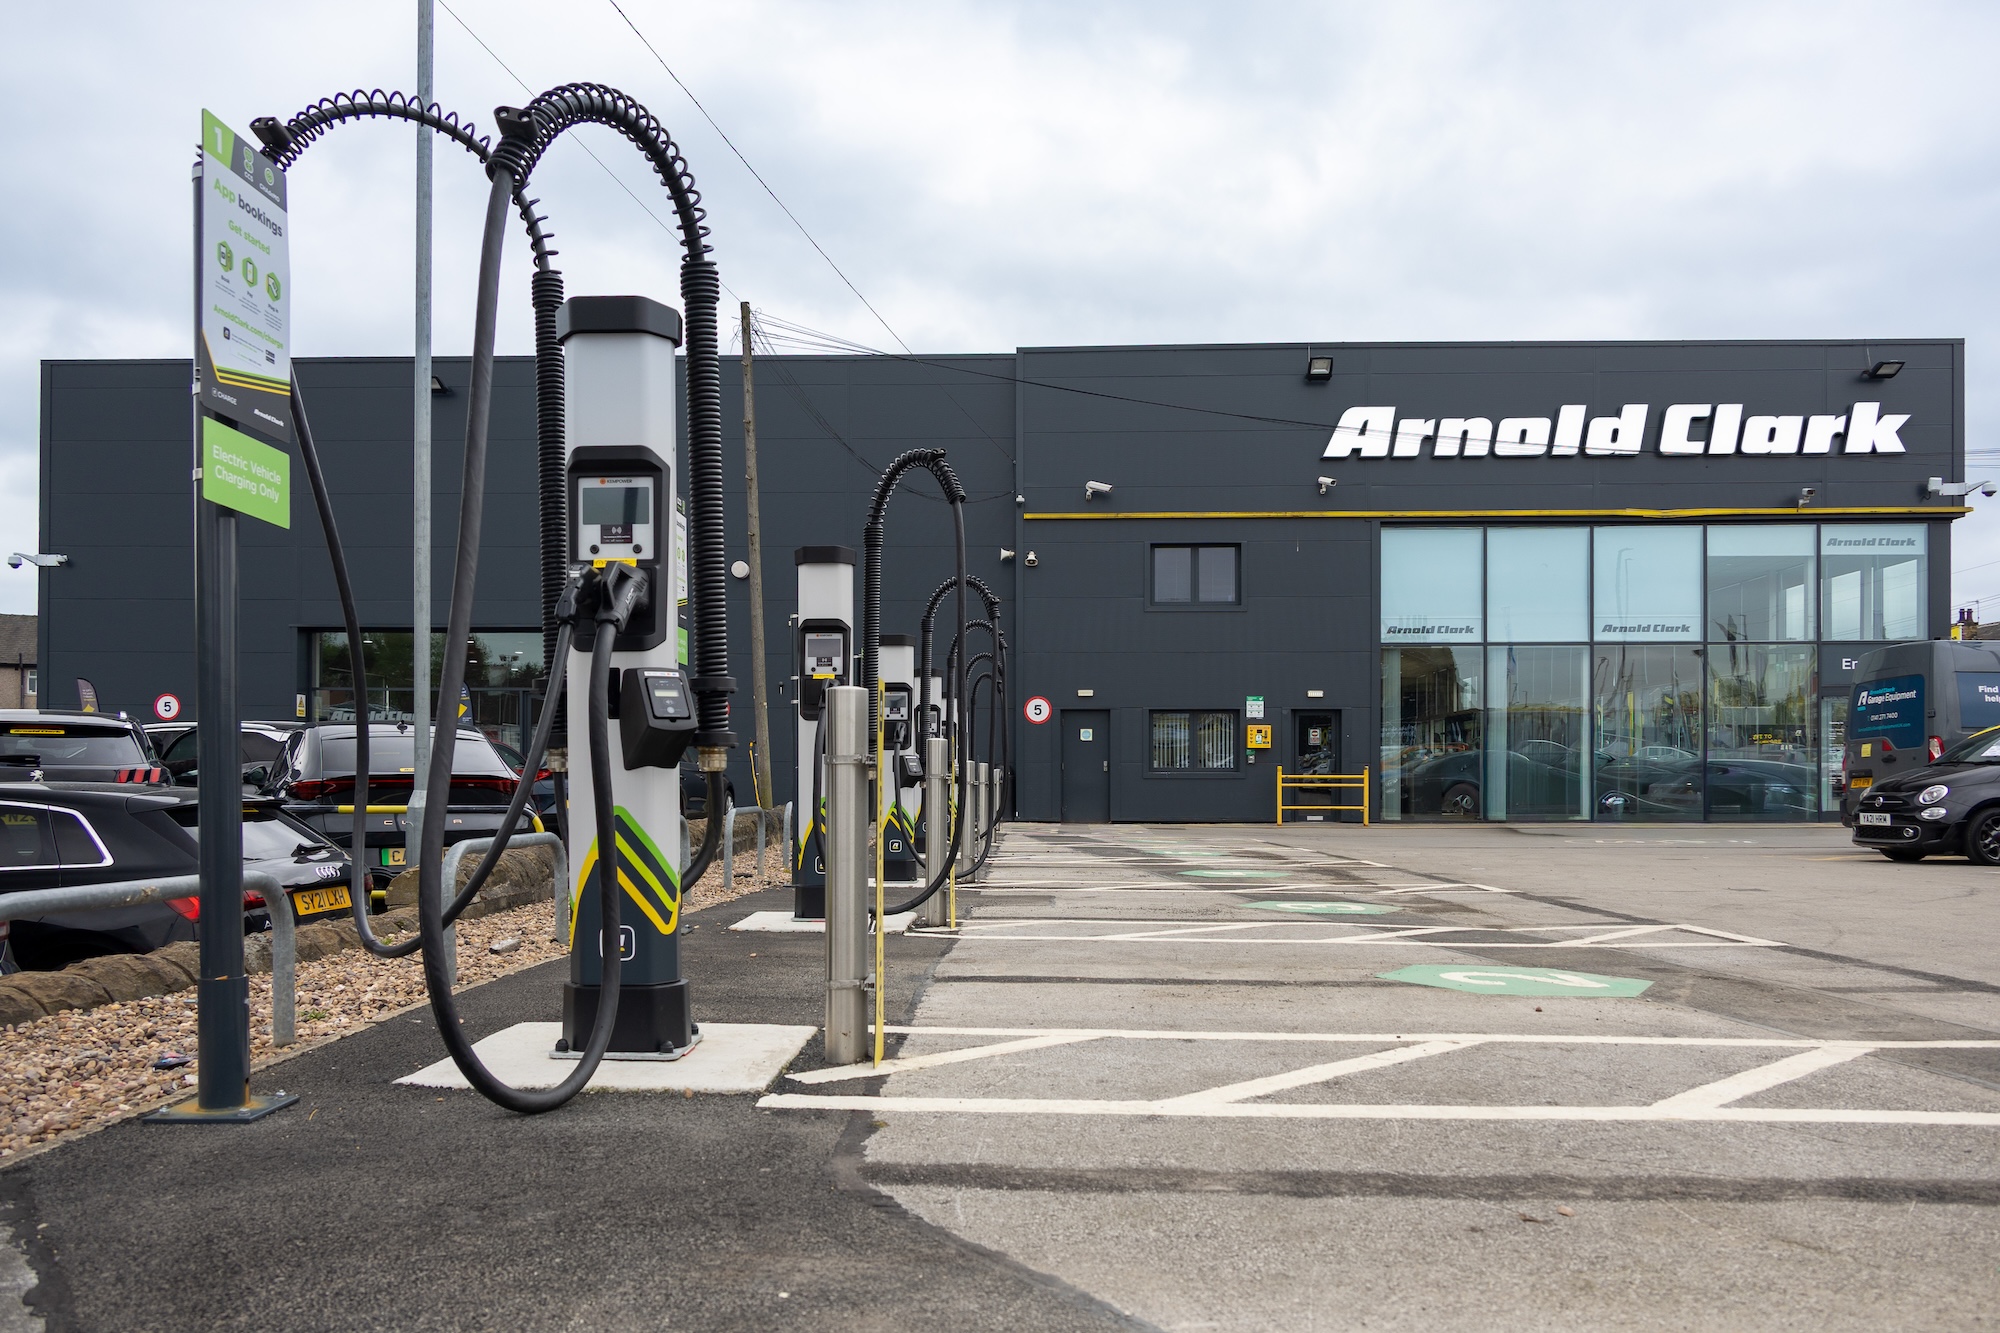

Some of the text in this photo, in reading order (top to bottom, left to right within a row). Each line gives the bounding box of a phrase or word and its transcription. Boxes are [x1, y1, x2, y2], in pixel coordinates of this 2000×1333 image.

[213, 126, 223, 155] 1
[213, 178, 283, 237] App bookings
[228, 219, 271, 256] Get started
[1320, 401, 1912, 459] Arnold Clark
[212, 444, 282, 485] Electric Vehicle
[214, 464, 280, 503] Charging Only
[1826, 537, 1917, 547] Arnold Clark
[1386, 625, 1475, 634] Arnold Clark
[1601, 623, 1691, 633] Arnold Clark
[1867, 690, 1917, 705] Garage Equipment
[1978, 685, 1999, 693] Find
[163, 701, 172, 712] 5
[1033, 705, 1042, 716] 5
[301, 888, 347, 911] SY21 LXH
[1439, 971, 1610, 988] 2
